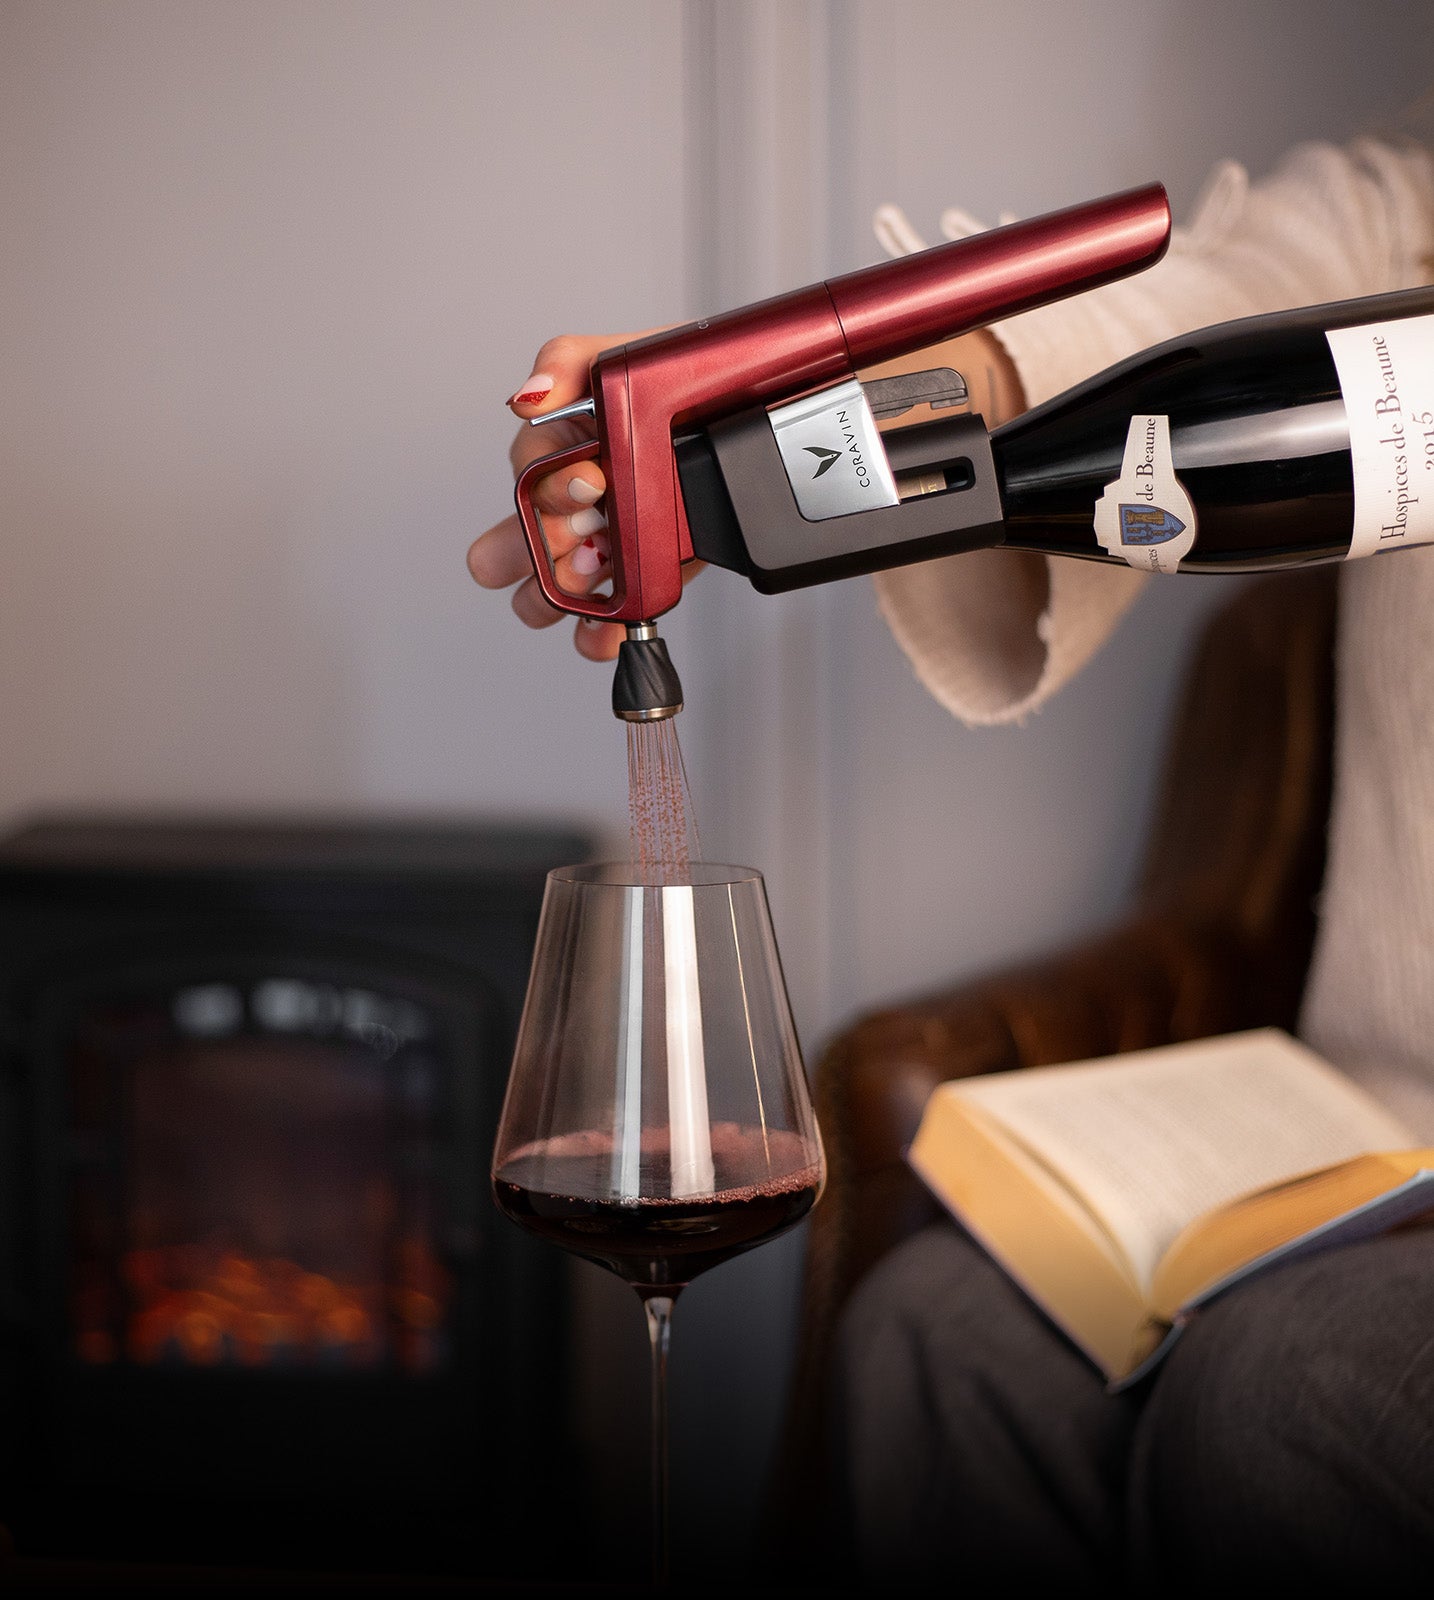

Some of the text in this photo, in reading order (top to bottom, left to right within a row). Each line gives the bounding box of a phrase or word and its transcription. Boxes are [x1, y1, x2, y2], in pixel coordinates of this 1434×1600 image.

[836, 410, 870, 487] CORAVIN
[1135, 418, 1156, 478] Beaune
[1372, 335, 1419, 540] Hospices de Beaune
[1136, 483, 1154, 501] de
